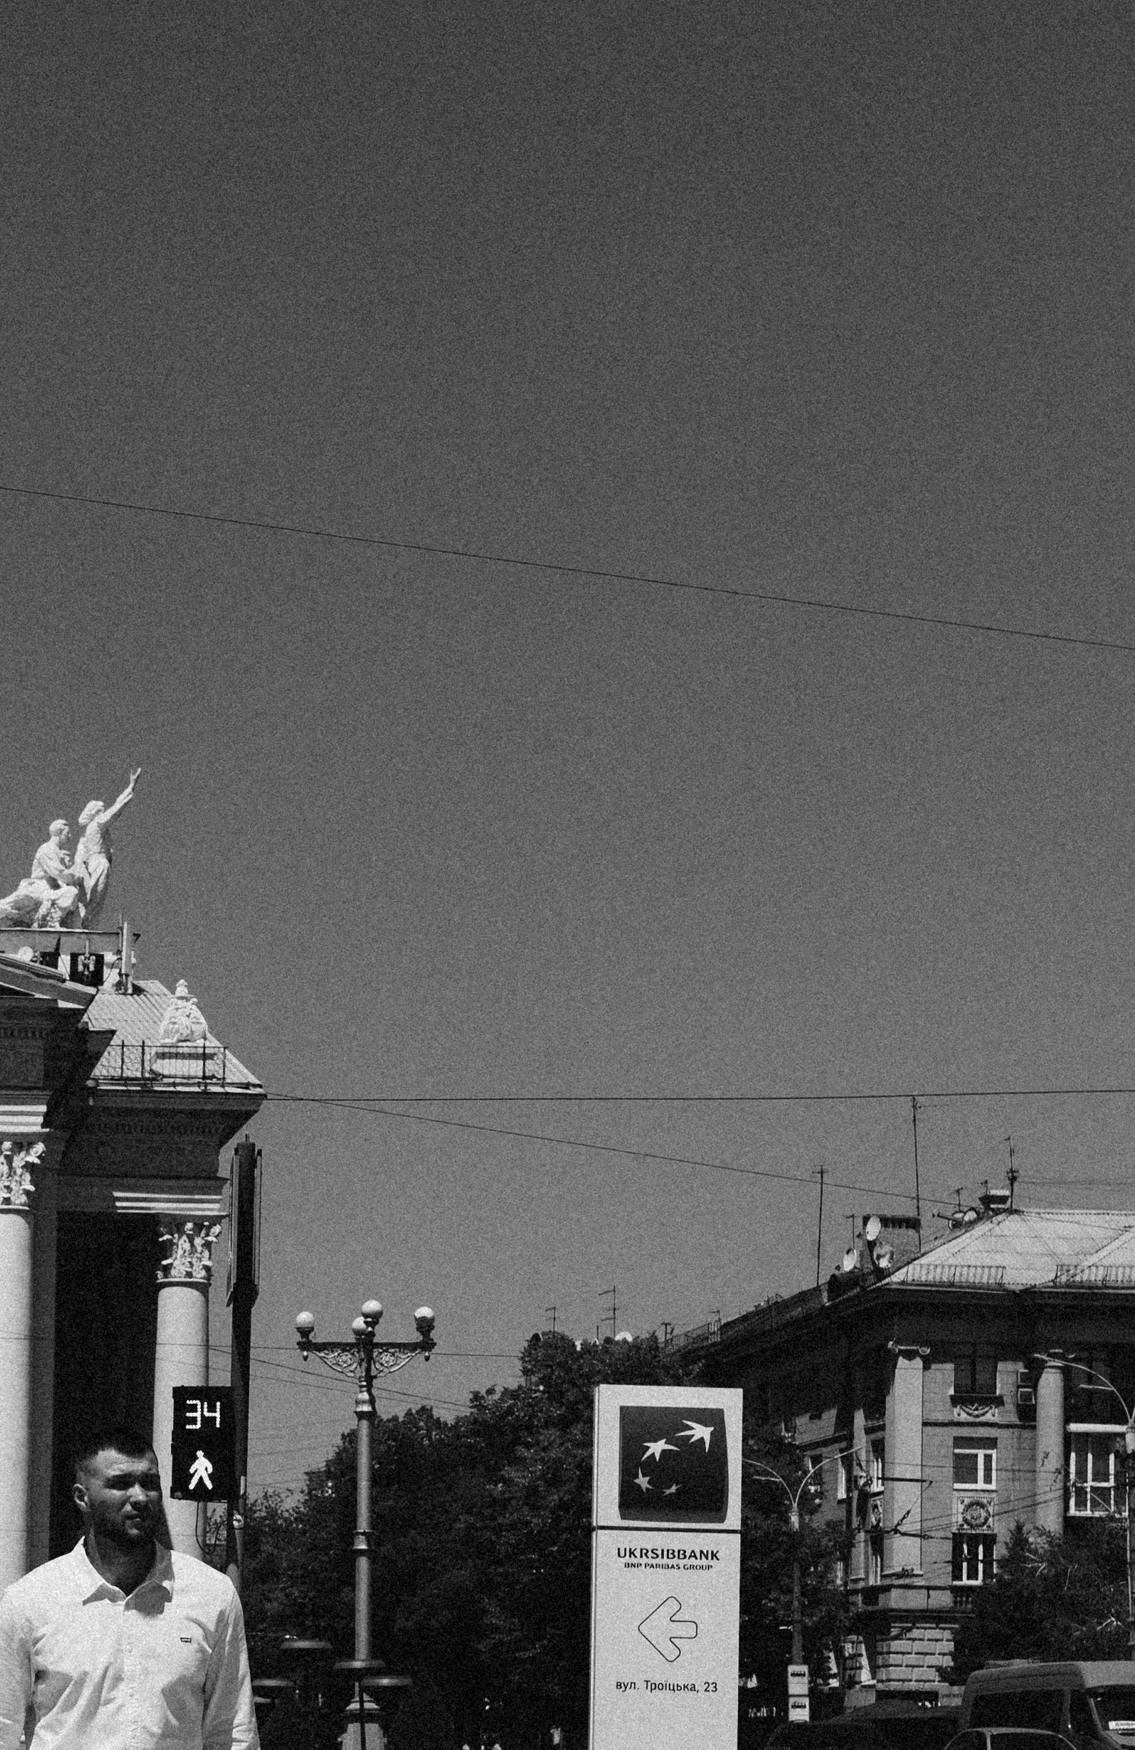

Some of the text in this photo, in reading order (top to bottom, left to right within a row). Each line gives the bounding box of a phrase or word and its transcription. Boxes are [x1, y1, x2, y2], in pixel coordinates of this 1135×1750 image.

[185, 1399, 221, 1430] 34
[617, 1547, 720, 1561] UKRSIBBANK
[644, 1562, 681, 1570] PARIBAS
[682, 1563, 713, 1571] GROUP
[615, 1679, 718, 1694] вул. Троїцька, 23
